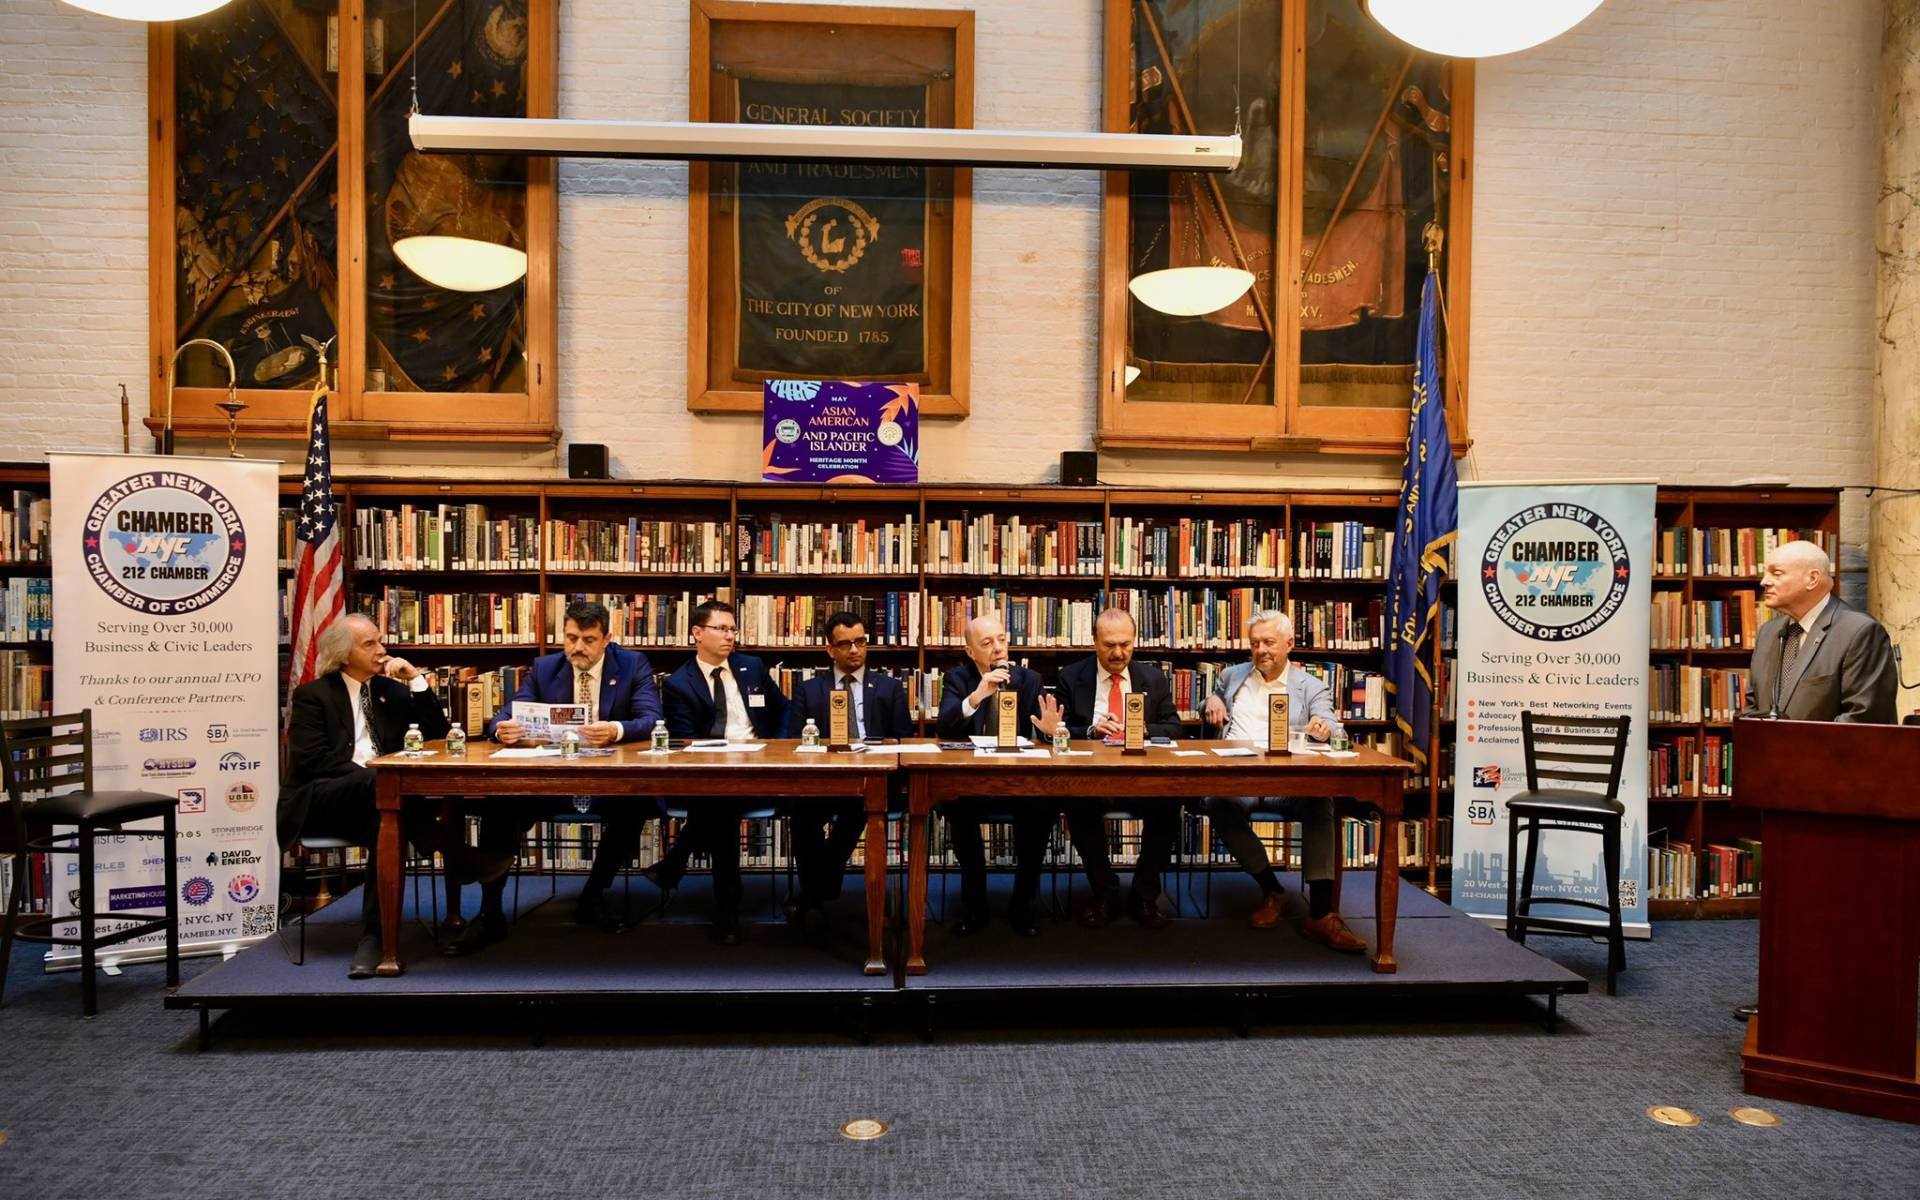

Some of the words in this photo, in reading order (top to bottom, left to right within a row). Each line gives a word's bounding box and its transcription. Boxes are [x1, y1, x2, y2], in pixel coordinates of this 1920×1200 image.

[746, 104, 832, 125] GENERAL
[840, 109, 920, 126] SOCIETY
[824, 286, 842, 295] OF
[745, 298, 772, 315] THE
[776, 302, 812, 317] CITY
[815, 304, 836, 318] OF
[839, 304, 874, 318] NEW
[877, 303, 919, 318] YORK
[775, 327, 848, 343] FOUNDED
[859, 331, 889, 343] 1785
[821, 406, 856, 416] ASIAN
[808, 416, 870, 427] AMERICAN
[802, 431, 828, 441] AND
[830, 431, 875, 442] PACIFIC
[810, 441, 867, 452] ISLANDER
[87, 474, 155, 532] GREATER
[161, 473, 206, 495] NEW
[207, 488, 242, 536] YORK
[117, 510, 213, 534] CHAMBER
[1486, 507, 1547, 562] GREATER
[1552, 505, 1593, 524] NEW
[1595, 519, 1627, 561] YORK
[138, 537, 192, 563] NYC
[1512, 541, 1599, 562] CHAMBER
[122, 566, 146, 579] 212
[150, 567, 208, 580] CHAMBER
[1530, 565, 1579, 591] NYC
[87, 553, 145, 609] CHAMBER
[148, 601, 171, 613] OF
[174, 556, 242, 612] COMMERCE
[1515, 595, 1536, 607] 212
[1540, 595, 1593, 607] CHAMBER
[1485, 584, 1535, 635] CHAMBER
[1538, 628, 1558, 639] OF
[1561, 583, 1626, 638] COMMERCE
[97, 622, 149, 636] Serving
[153, 622, 186, 633] Over
[85, 641, 144, 653] Business
[147, 641, 160, 652] &
[164, 641, 199, 652] Civic
[203, 641, 253, 652] Leaders
[1481, 651, 1533, 666] Serving
[1537, 652, 1570, 664] Over
[80, 674, 129, 686] Thanks
[132, 675, 146, 685] to
[149, 676, 173, 685] our
[175, 673, 222, 684] annual
[225, 673, 262, 683] EXPO
[1467, 672, 1524, 684] Business
[1528, 673, 1541, 685] &
[1546, 673, 1581, 685] Civic
[1586, 673, 1640, 686] Leaders
[94, 695, 106, 706] &
[108, 694, 186, 706] Conference
[188, 693, 246, 704] Partners.
[1500, 700, 1525, 708] York's
[1553, 701, 1600, 711] Networking
[1604, 702, 1633, 710] Events
[1478, 712, 1516, 721] Advocacy
[160, 728, 188, 741] IRS
[206, 728, 230, 739] SBA
[1478, 724, 1523, 732] Profession
[1535, 726, 1553, 734] egal
[1478, 736, 1520, 745] Acclaimed
[220, 761, 261, 771] NYSIF
[1468, 806, 1496, 819] SBA
[211, 825, 264, 834] STONEBRIDGE
[142, 855, 192, 866] SHENEN
[221, 850, 251, 859] DAVID
[221, 856, 262, 866] ENERGY
[67, 861, 126, 873] CRLES
[1464, 880, 1475, 888] 20
[1478, 880, 1500, 889] West
[1531, 884, 1555, 893] treet,
[1583, 886, 1600, 894] NY
[216, 913, 235, 923] NY
[63, 927, 78, 936] 20
[94, 923, 112, 934] est
